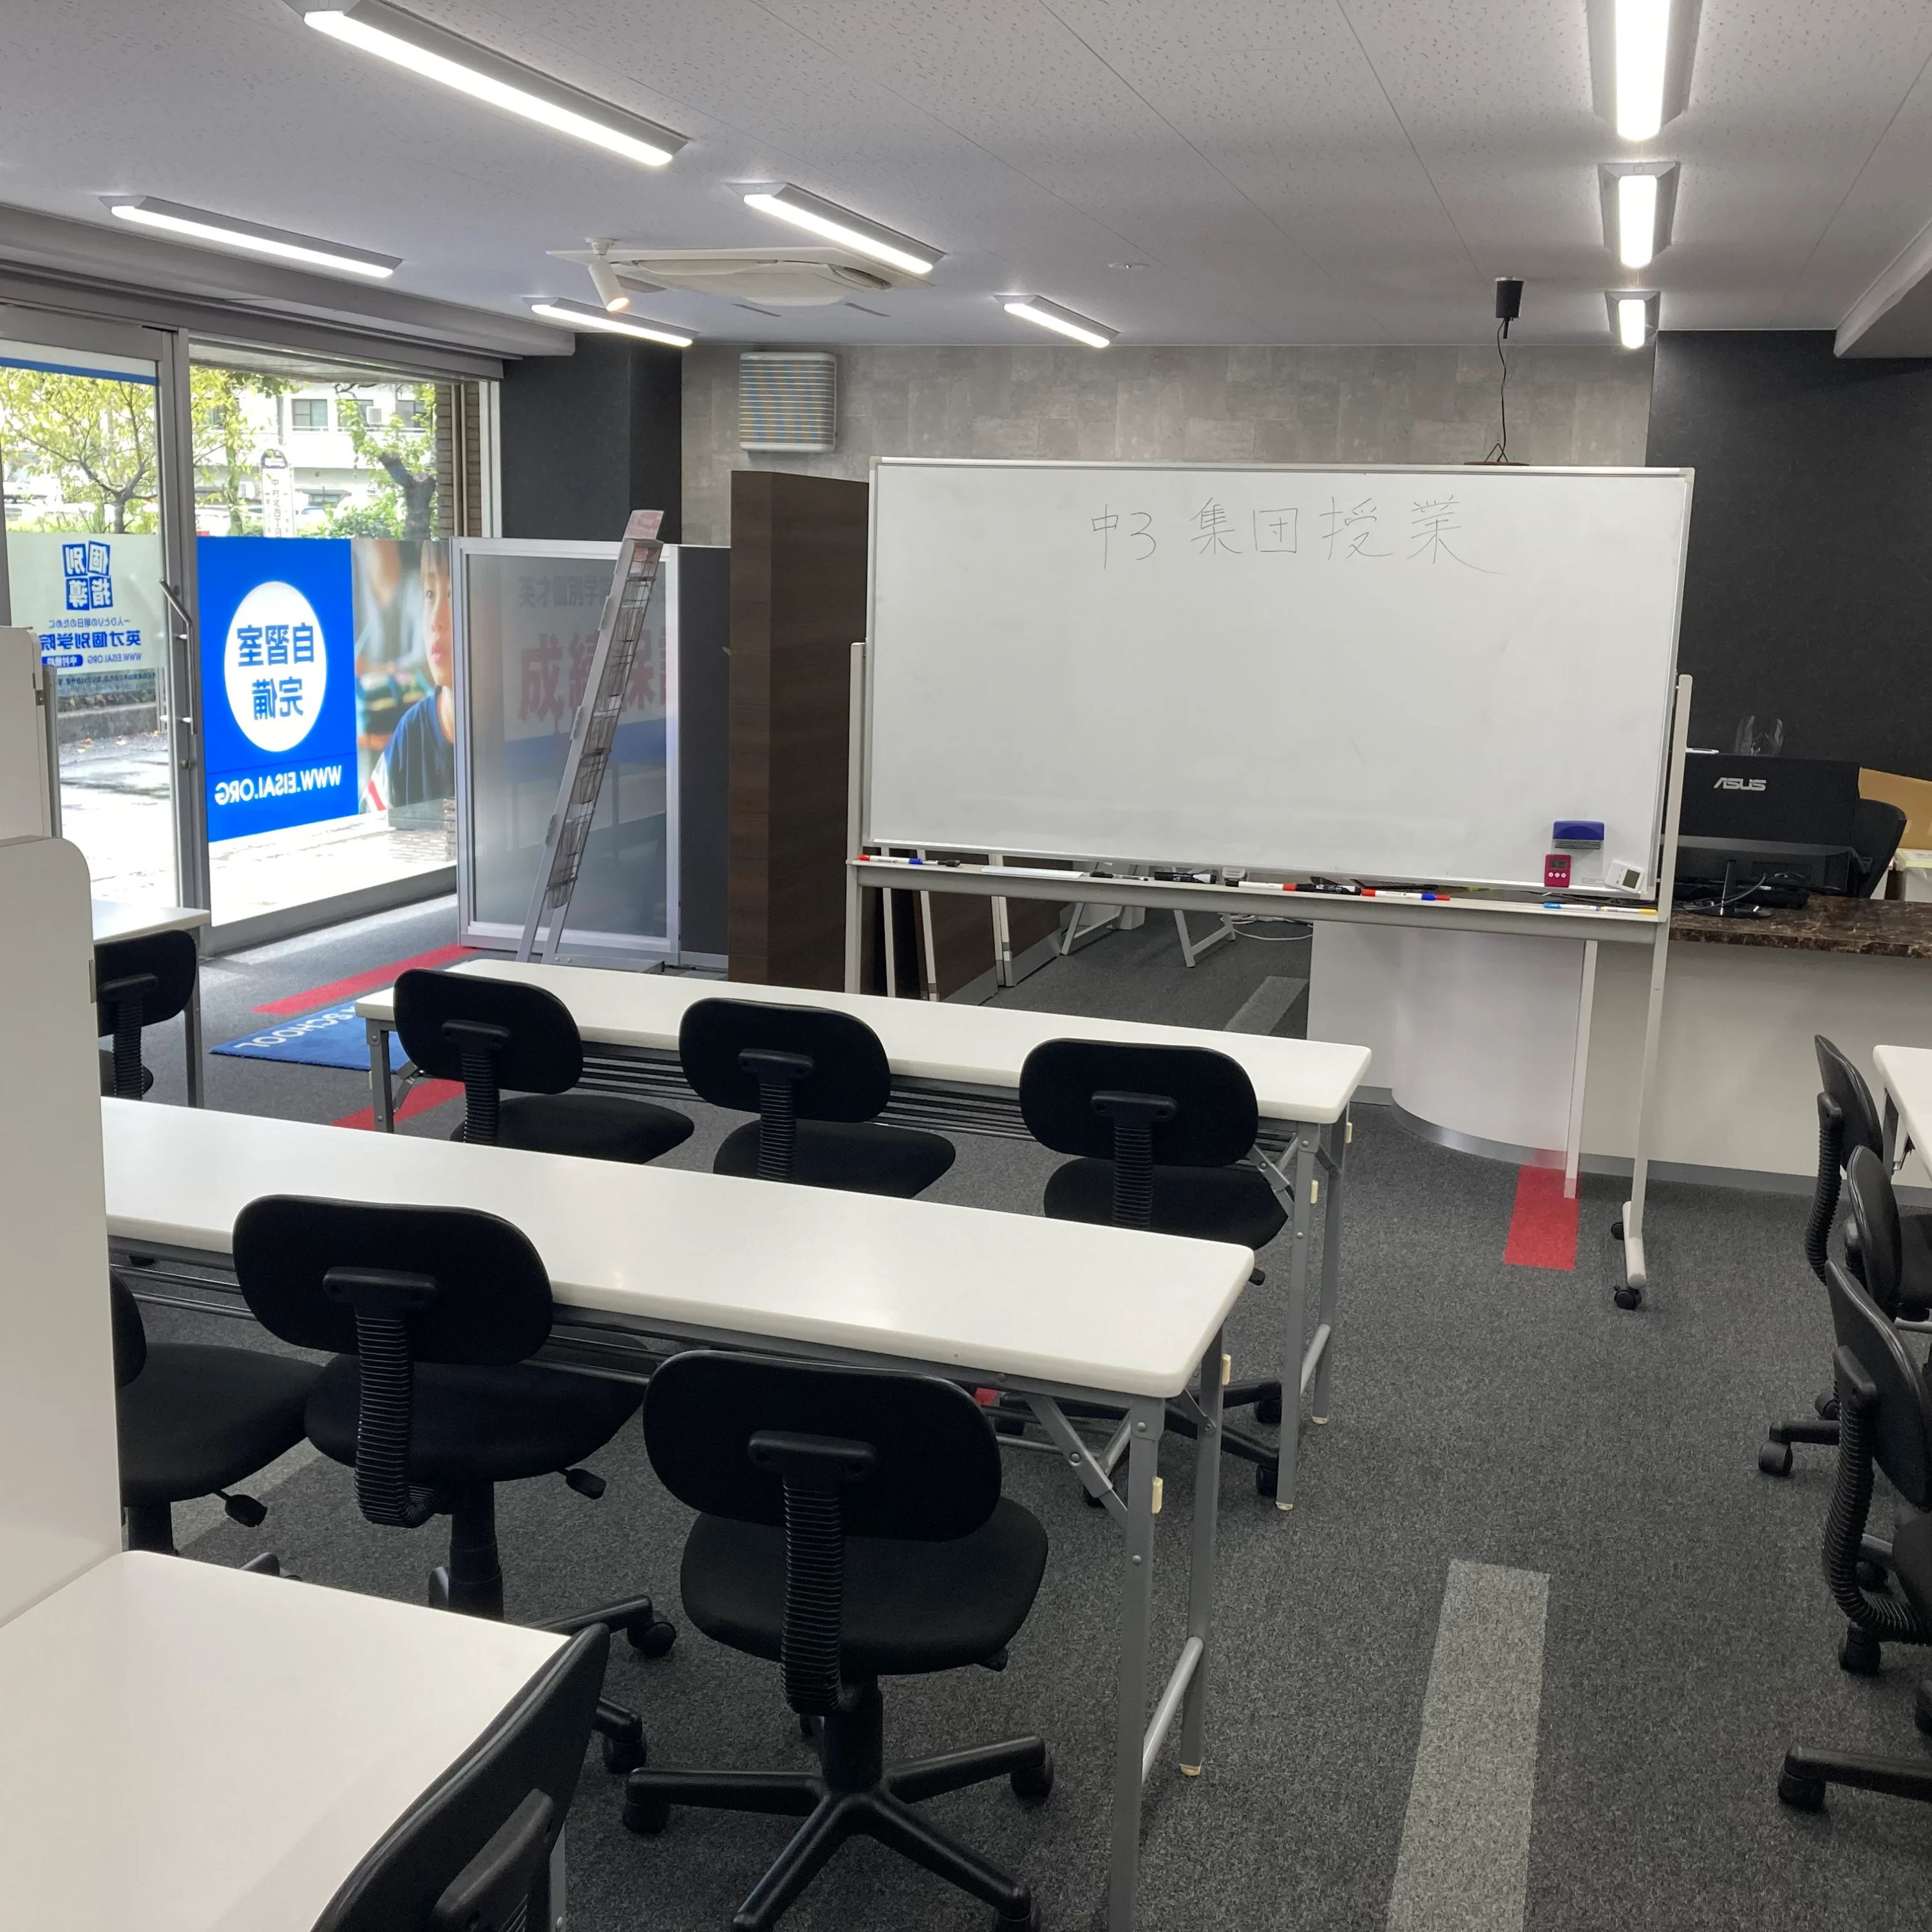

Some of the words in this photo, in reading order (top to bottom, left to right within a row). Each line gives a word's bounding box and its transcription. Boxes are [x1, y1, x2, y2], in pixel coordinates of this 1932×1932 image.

[1090, 503, 1157, 569] 中3
[1190, 495, 1508, 575] 集団授業
[1713, 777, 1766, 791] ASUS
[233, 1013, 354, 1048] SCHOOL
